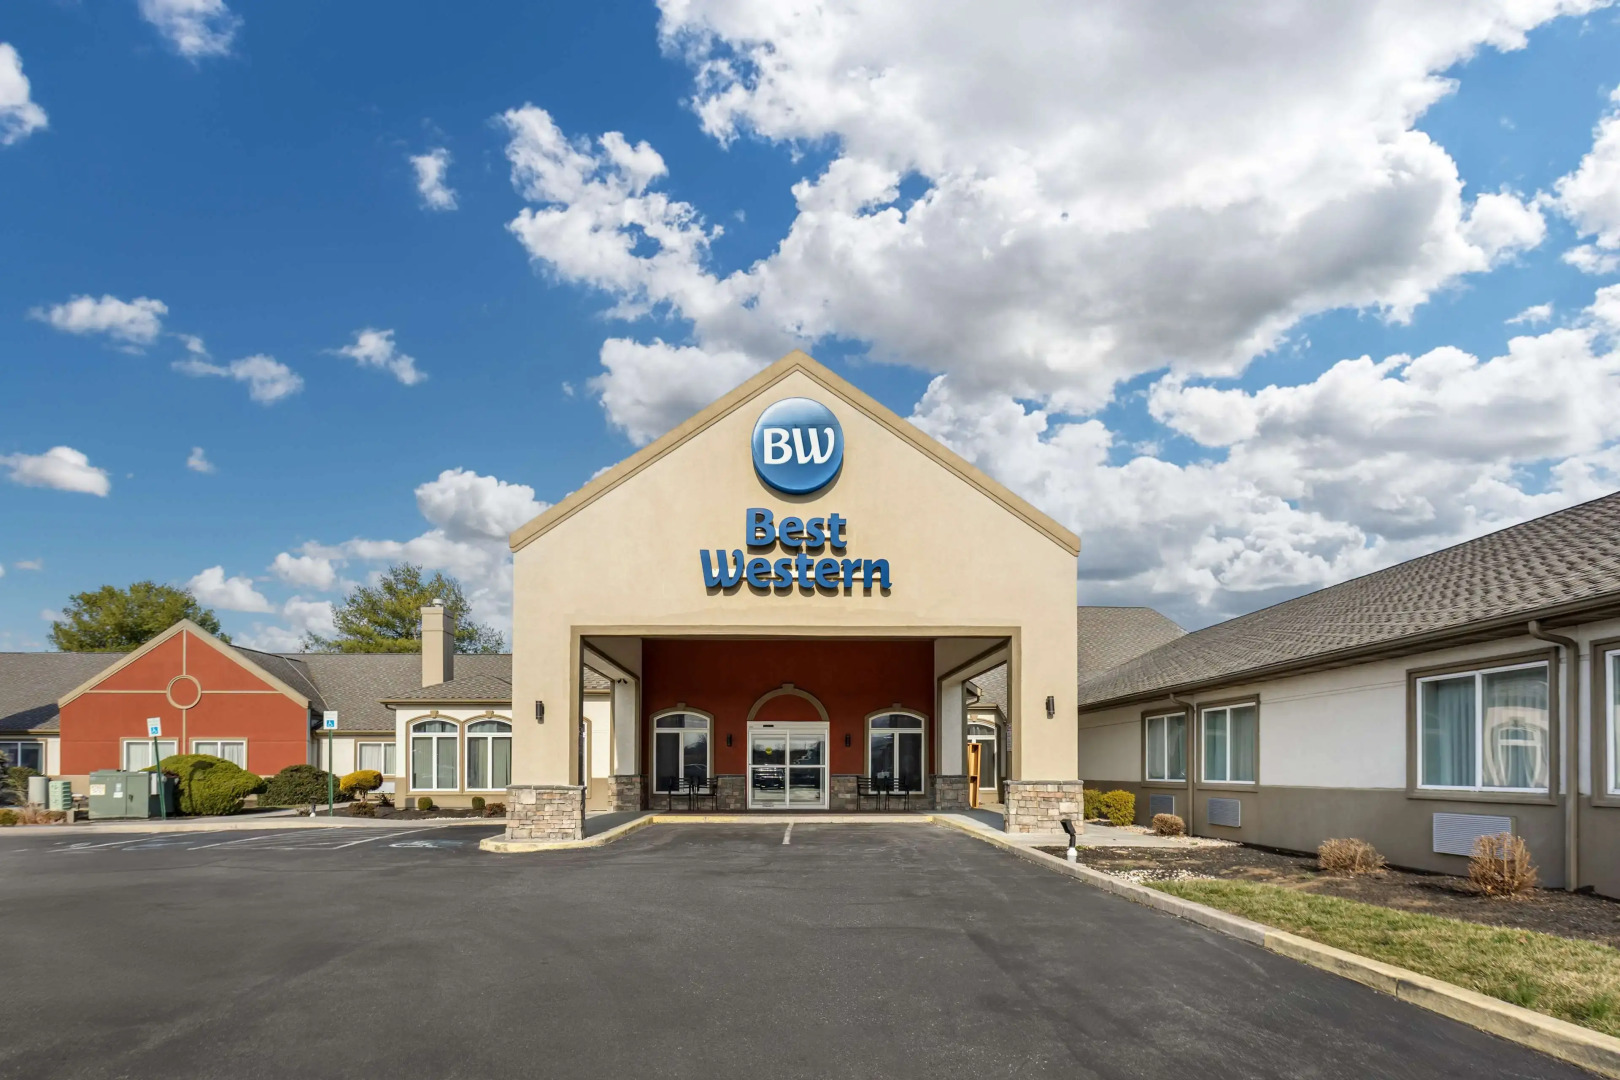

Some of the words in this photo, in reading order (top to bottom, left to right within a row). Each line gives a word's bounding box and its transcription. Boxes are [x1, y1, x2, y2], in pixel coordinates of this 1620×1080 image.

[763, 427, 835, 465] BW
[746, 507, 848, 548] Best
[699, 548, 893, 590] Western
